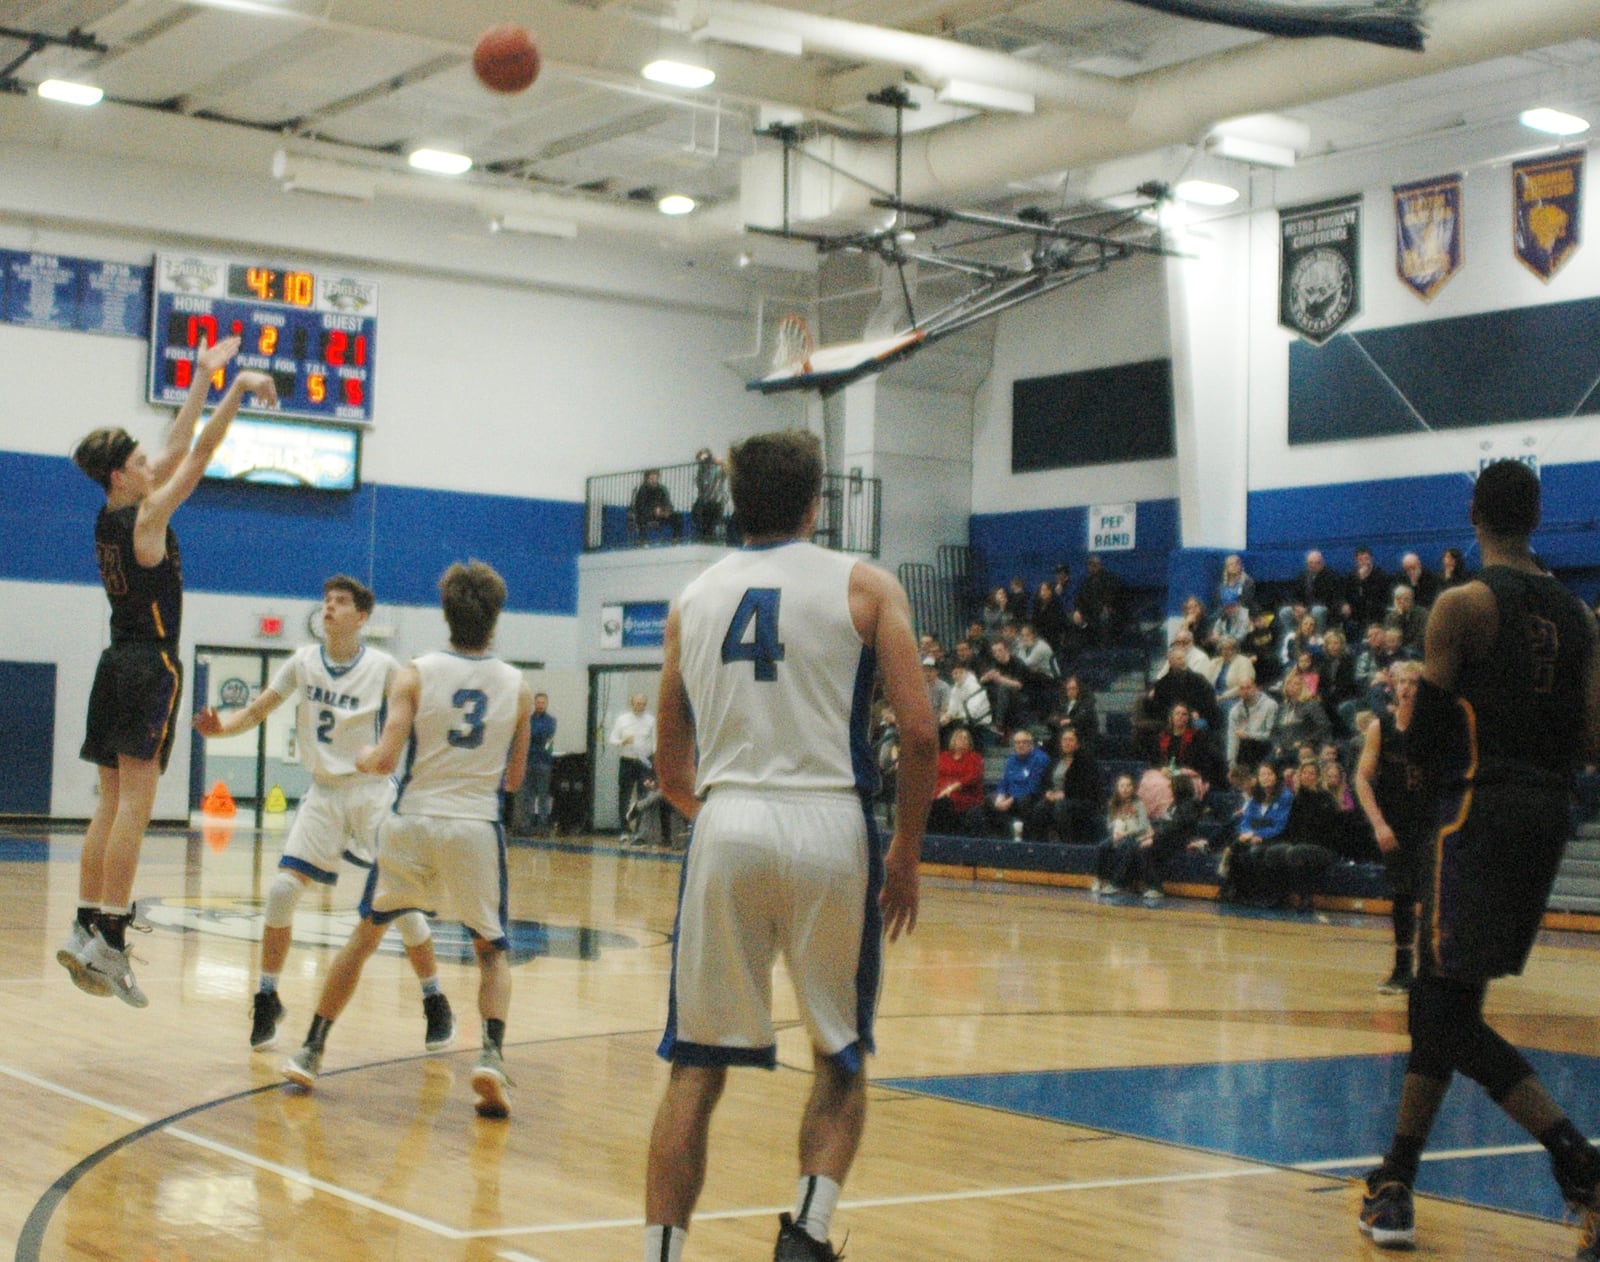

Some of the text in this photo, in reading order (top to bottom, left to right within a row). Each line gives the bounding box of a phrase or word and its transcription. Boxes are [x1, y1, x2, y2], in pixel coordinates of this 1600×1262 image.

[247, 266, 314, 307] 4:10
[174, 296, 213, 313] HOME
[253, 311, 286, 328] PERIOD
[323, 314, 364, 331] GUEST
[187, 314, 217, 349] 17
[259, 325, 278, 356] 2
[165, 347, 195, 361] FOULS
[325, 330, 367, 368] 21
[237, 354, 296, 372] PLAYER FOUL
[338, 366, 367, 381] FOULS
[307, 374, 326, 404] 5
[335, 406, 366, 419] SCORE
[1101, 515, 1124, 529] PEP
[1094, 533, 1130, 547] BAND
[721, 587, 785, 682] 4
[317, 710, 336, 744] 2
[447, 689, 488, 749] 3
